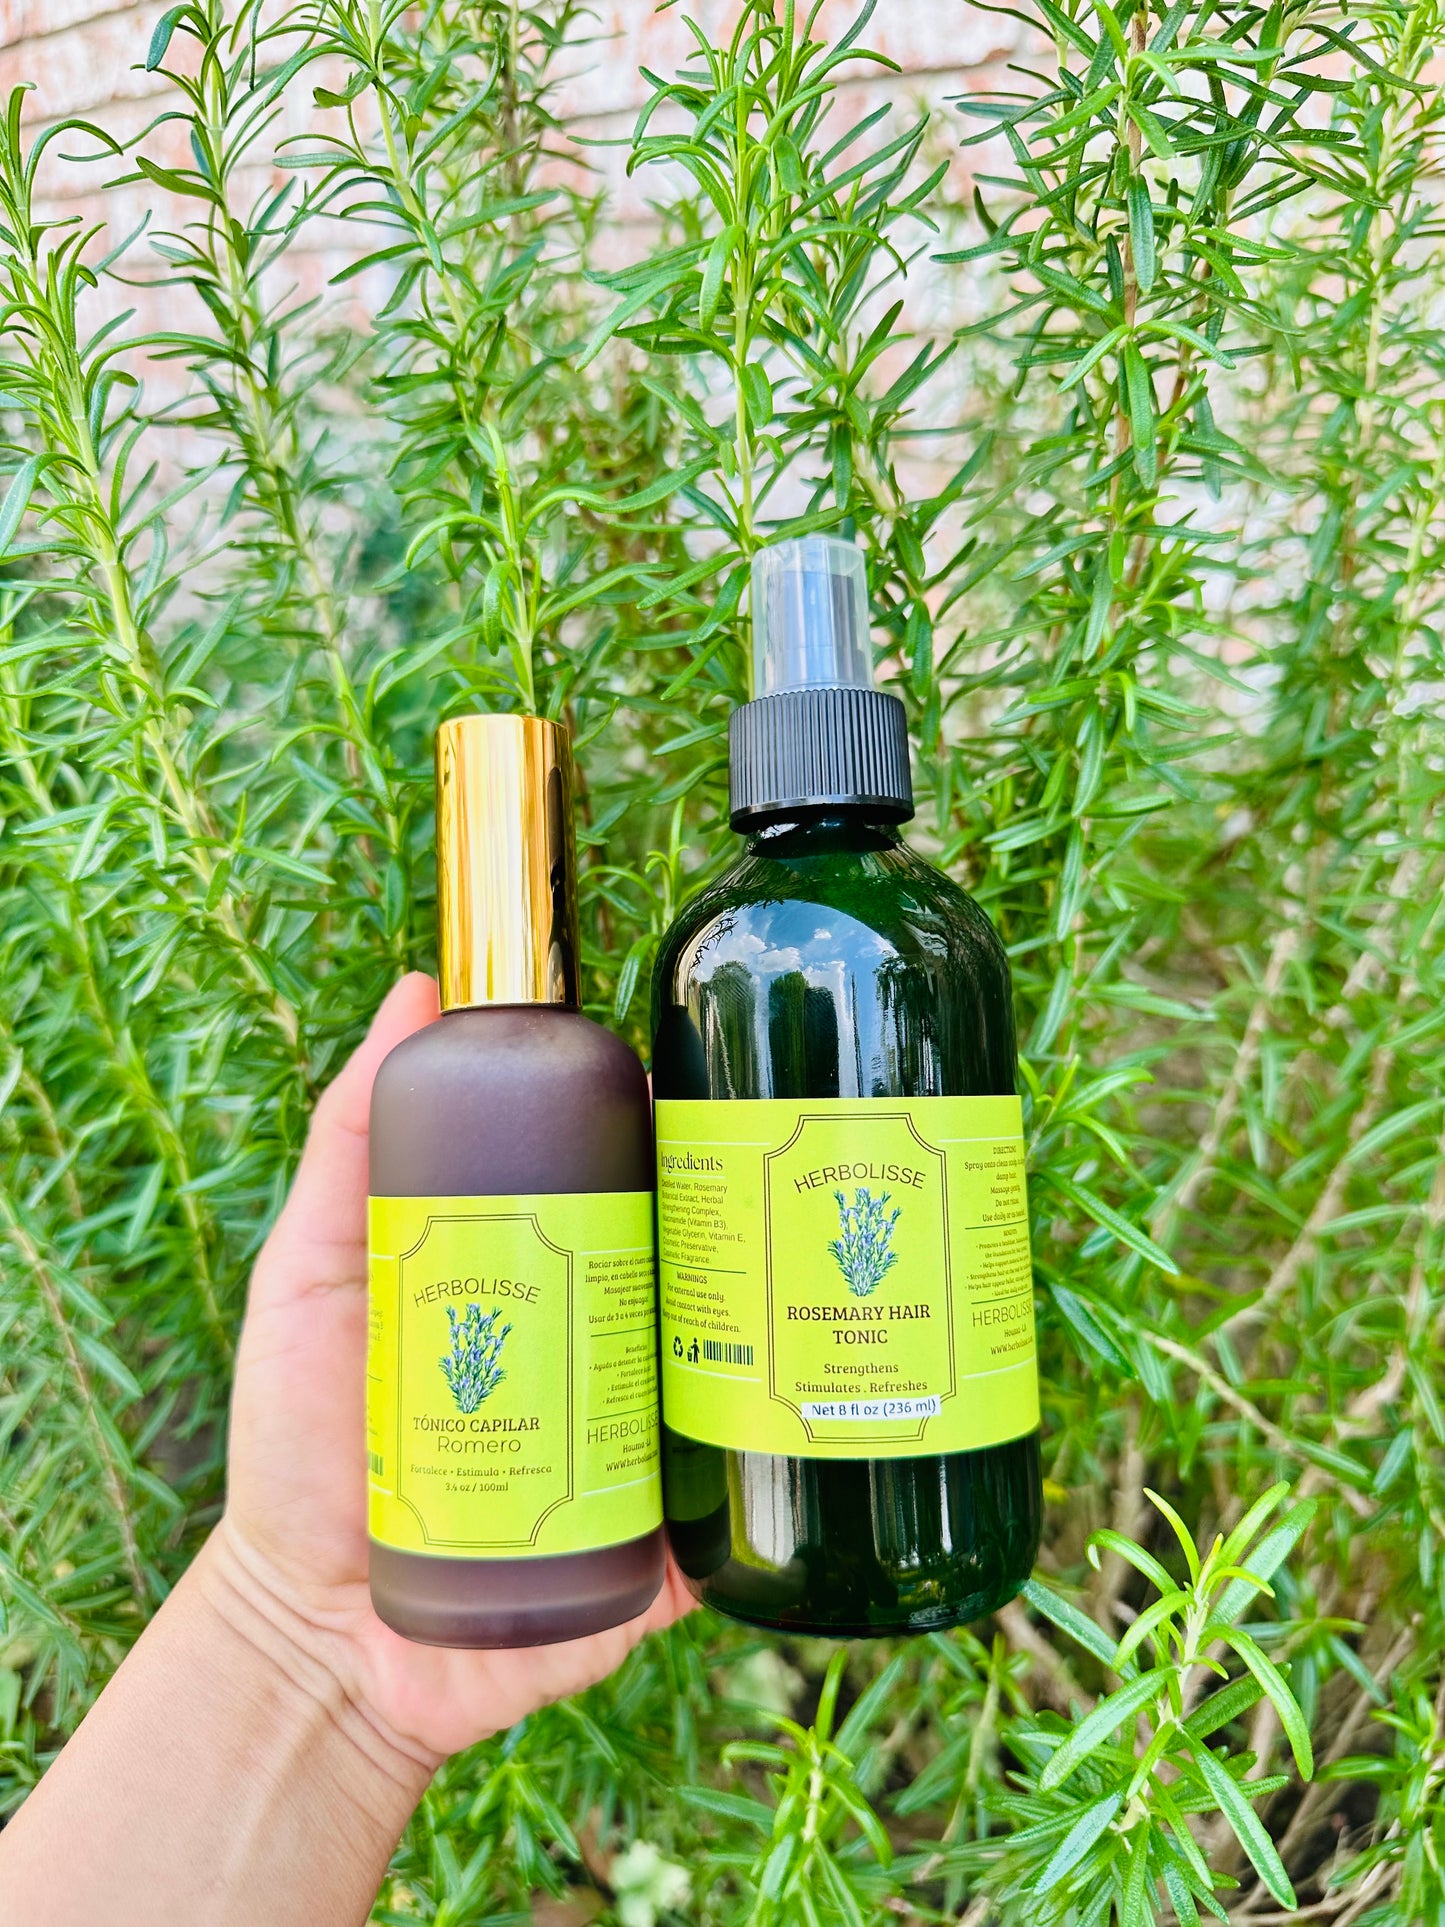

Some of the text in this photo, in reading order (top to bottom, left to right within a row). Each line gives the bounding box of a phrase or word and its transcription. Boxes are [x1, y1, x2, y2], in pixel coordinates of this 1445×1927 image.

[661, 1152, 723, 1173] Ingredients
[964, 1161, 983, 1171] Spray
[793, 1162, 926, 1194] HERBOLISSE
[694, 1182, 728, 1194] Rosemary
[701, 1195, 724, 1204] Herbal
[692, 1206, 721, 1217] Complex,
[708, 1232, 735, 1241] Vitamin
[737, 1233, 746, 1243] E,
[681, 1240, 719, 1253] Preservative,
[588, 1261, 612, 1269] Rociar
[613, 1258, 629, 1267] sobre
[585, 1274, 610, 1284] limpio,
[676, 1271, 707, 1284] WARNINGS
[413, 1277, 541, 1308] HERBOLISSE
[604, 1285, 631, 1295] Masajear
[674, 1286, 695, 1297] external
[697, 1291, 706, 1299] use
[619, 1298, 627, 1306] No
[677, 1300, 695, 1311] contact
[697, 1304, 711, 1314] with
[713, 1307, 730, 1317] eyes.
[588, 1315, 605, 1323] Usar
[607, 1312, 614, 1321] de
[615, 1312, 619, 1321] 3
[787, 1304, 931, 1321] ROSEMARY HAIR
[683, 1316, 699, 1327] reach
[700, 1319, 707, 1328] of
[708, 1320, 741, 1332] children.
[832, 1329, 888, 1344] TONIC
[824, 1362, 899, 1377] Strengthens
[795, 1380, 928, 1393] Stimulates Refreshes
[811, 1398, 937, 1417] Net 8 fl oz (236 ml)
[413, 1414, 540, 1432] TÓNICO CAPILAR
[437, 1435, 522, 1453] Romero
[410, 1464, 552, 1477] Fortalece Estimula Refresca
[445, 1482, 509, 1492] 3.4 oz / 100ml
